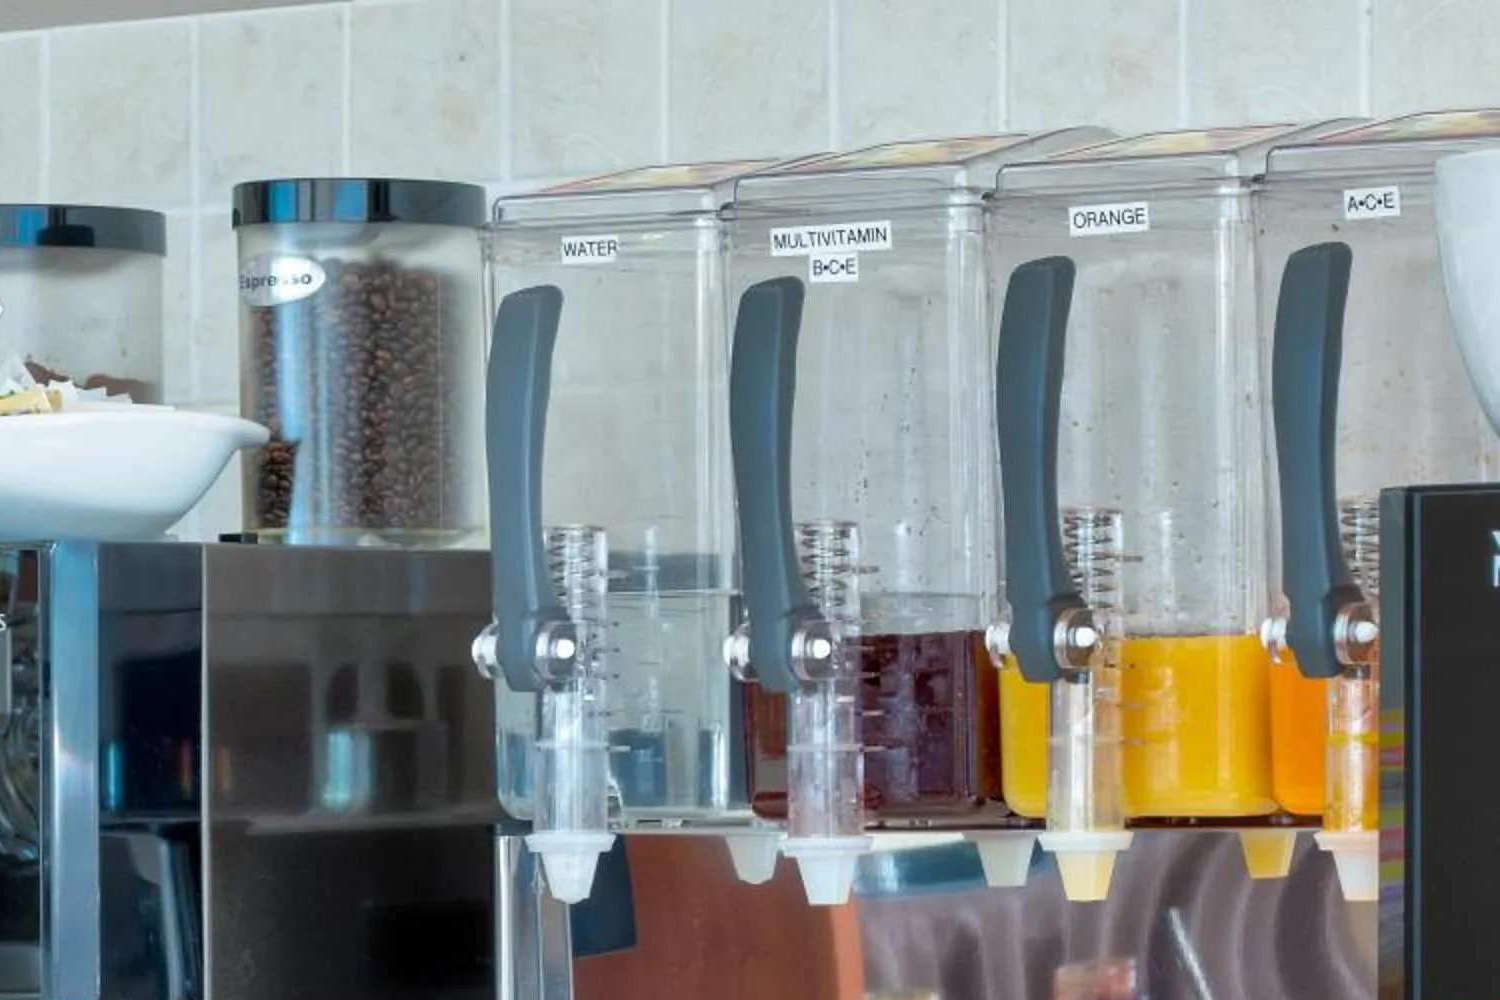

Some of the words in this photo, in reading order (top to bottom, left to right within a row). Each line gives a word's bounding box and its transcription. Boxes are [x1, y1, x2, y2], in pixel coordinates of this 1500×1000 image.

[1073, 207, 1146, 229] ORANGE
[563, 240, 618, 257] WATER
[772, 226, 888, 249] MULTIVITAMIN
